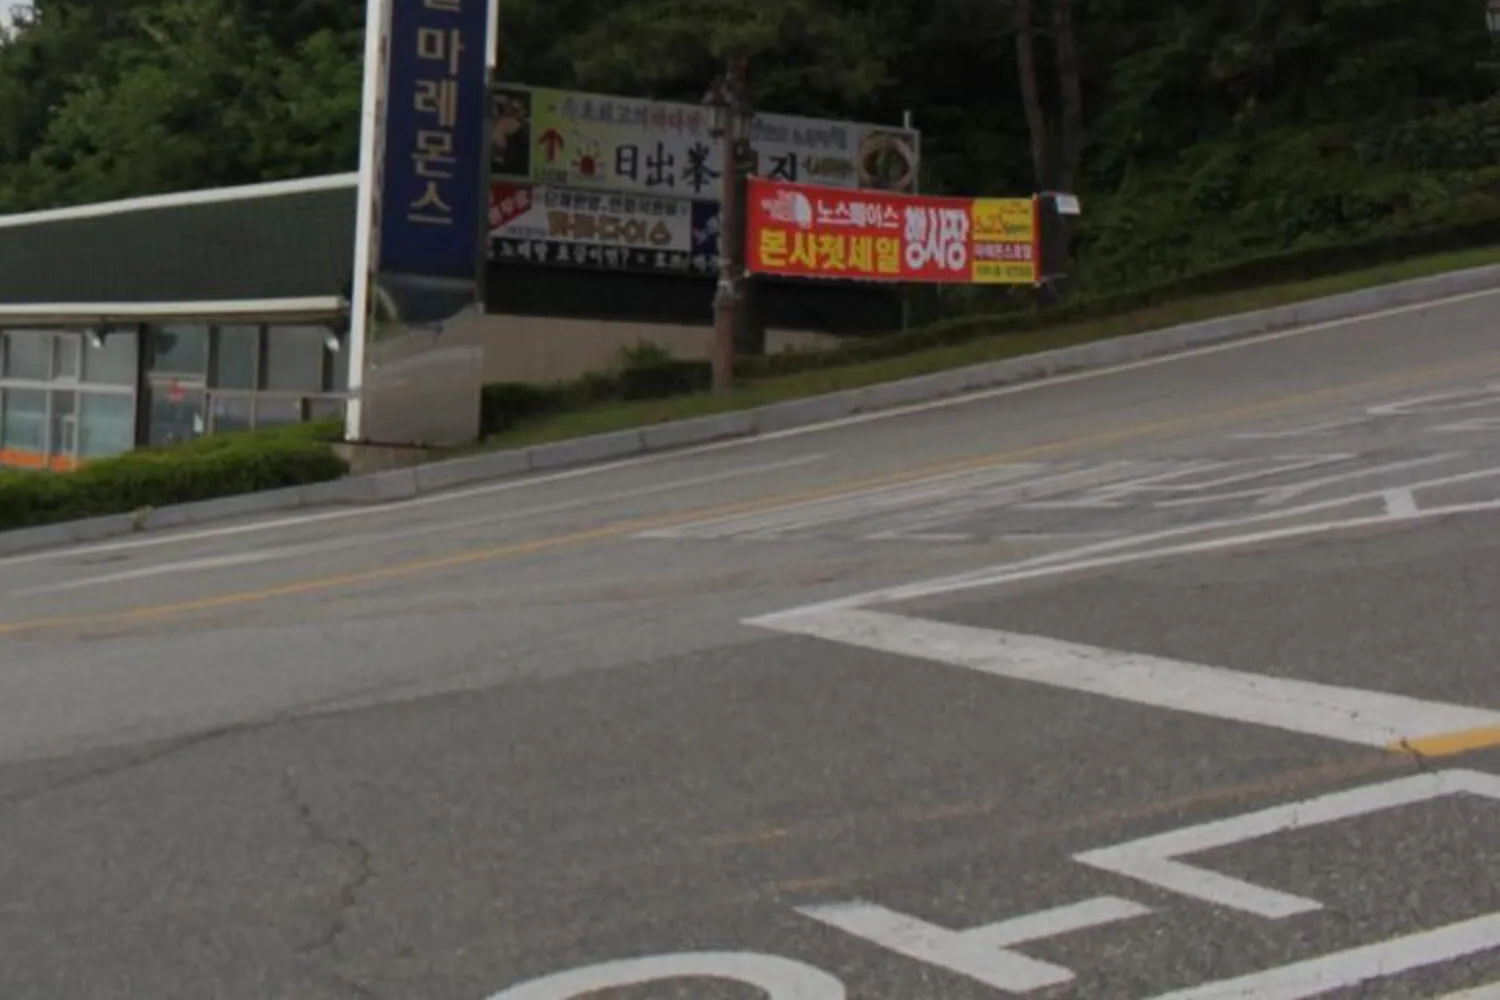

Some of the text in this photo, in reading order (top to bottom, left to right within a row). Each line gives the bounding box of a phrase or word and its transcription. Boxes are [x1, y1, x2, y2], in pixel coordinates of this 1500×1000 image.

[407, 26, 465, 225] 마레몬스
[816, 200, 900, 229] 노스페이스
[905, 205, 970, 270] 행사장
